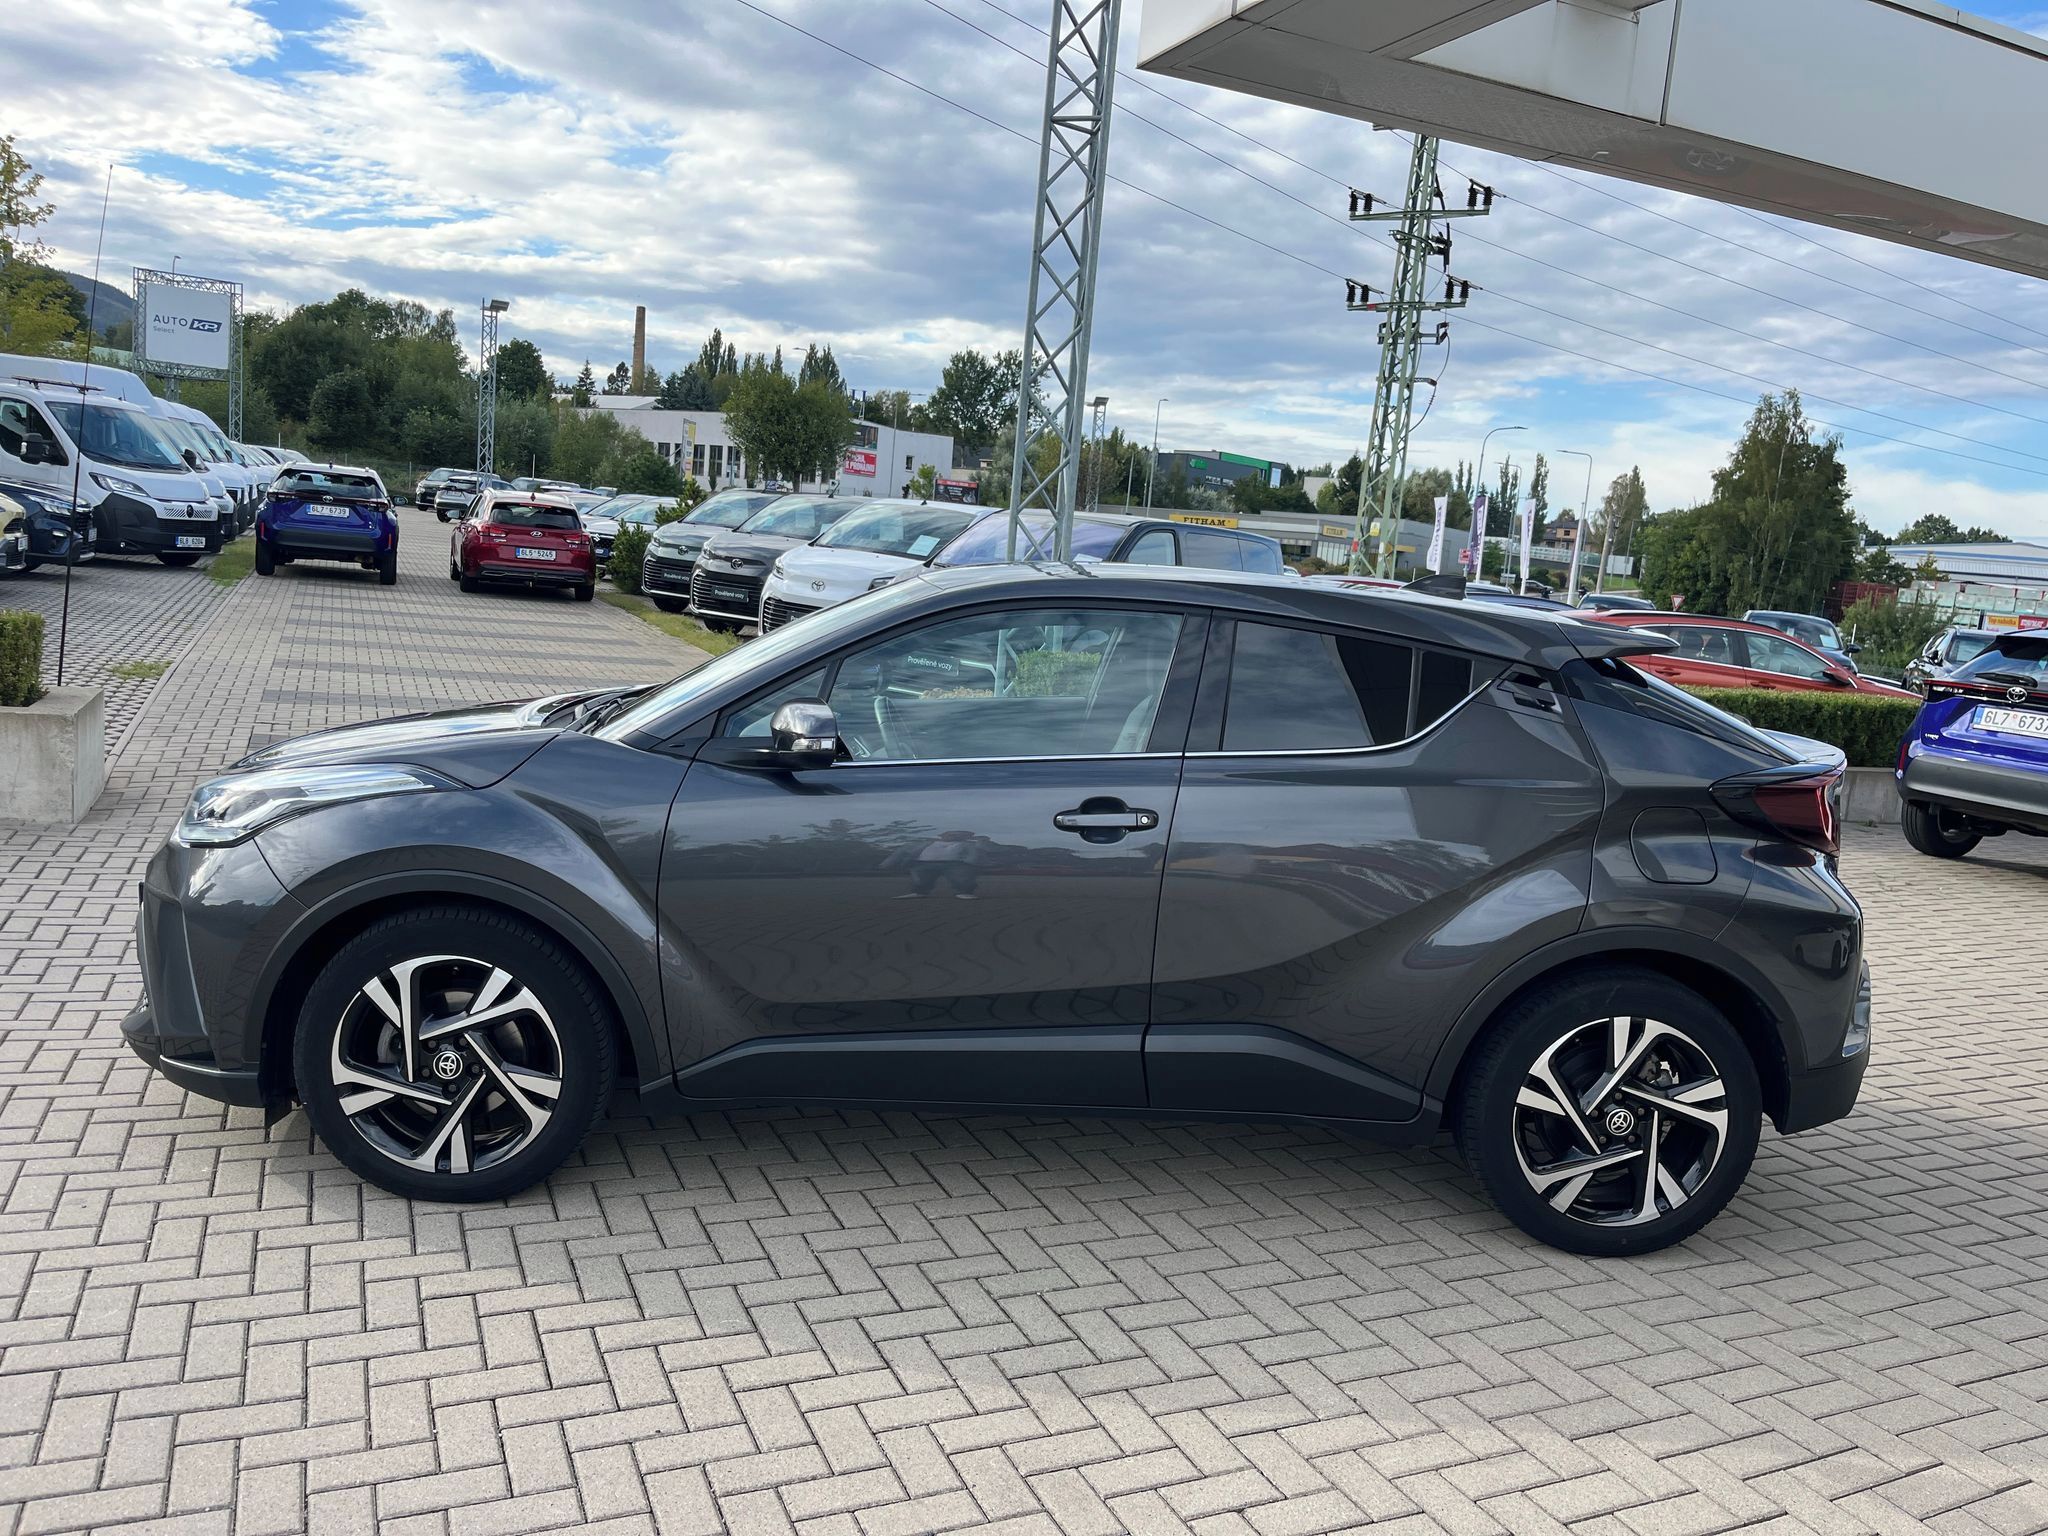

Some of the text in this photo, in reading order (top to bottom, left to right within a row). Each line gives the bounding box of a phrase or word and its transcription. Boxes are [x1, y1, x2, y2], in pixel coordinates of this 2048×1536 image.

[153, 314, 188, 327] AUTO
[311, 505, 325, 513] 6L7
[1183, 516, 1226, 526] FITHAM
[520, 548, 553, 558] 6L5 5245
[907, 655, 953, 671] Prověřené vozy
[1984, 710, 2011, 726] 6L7
